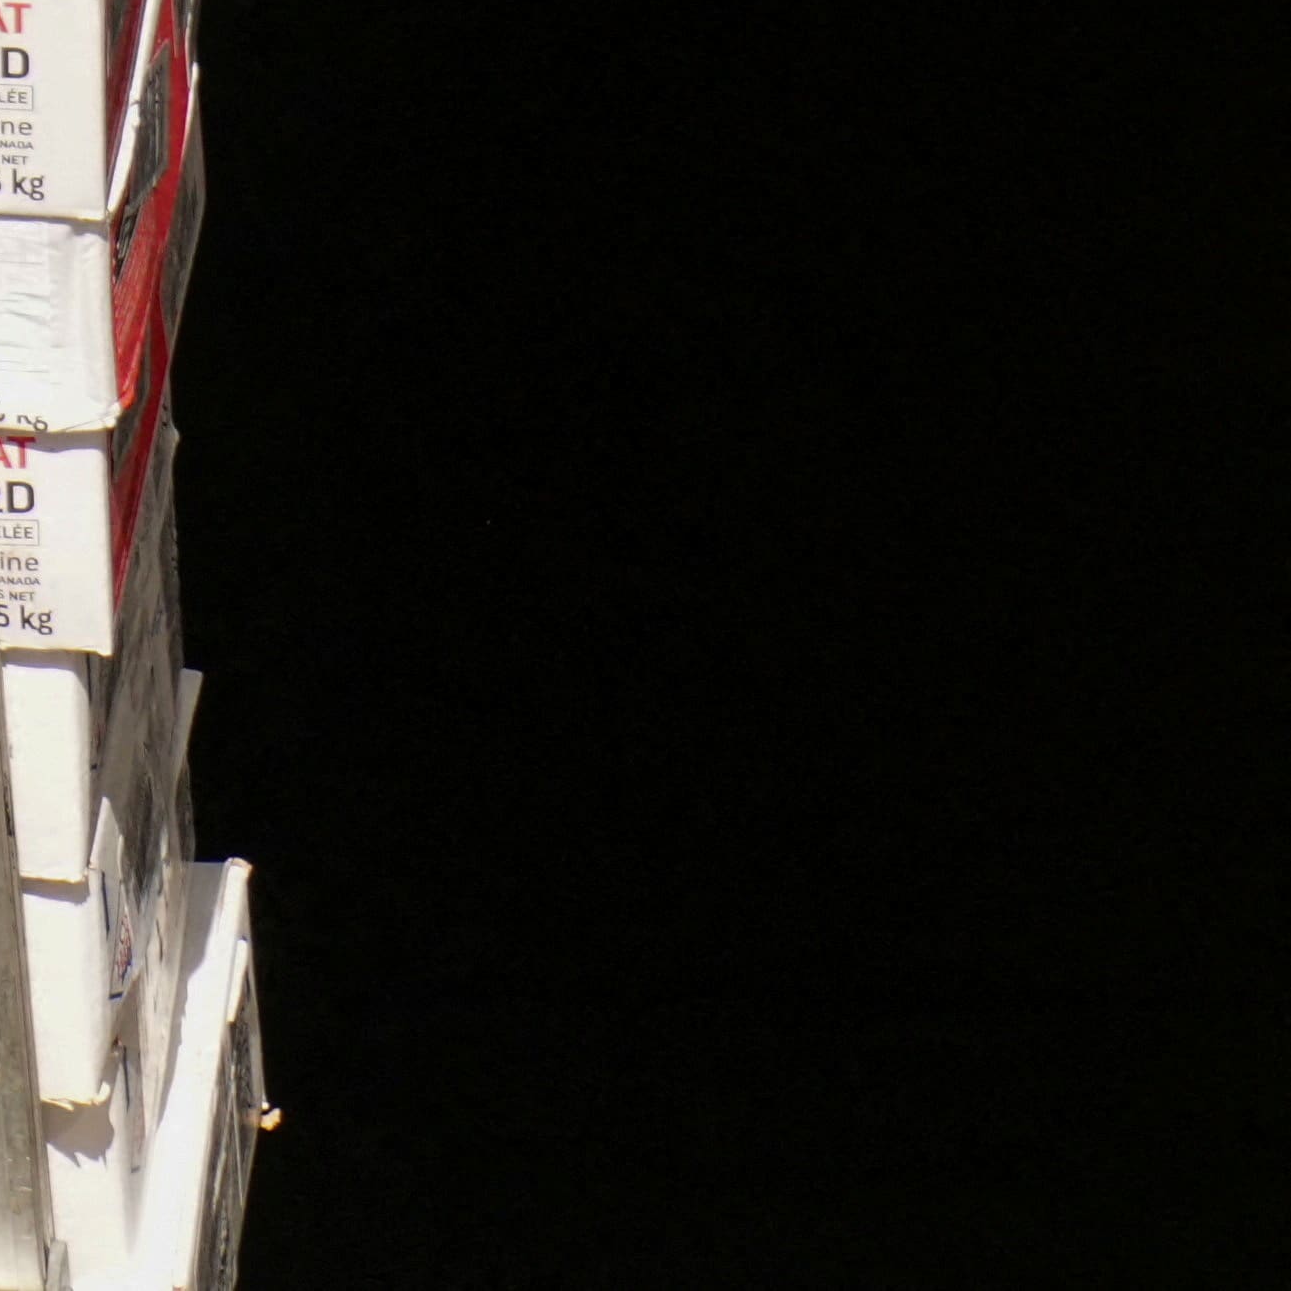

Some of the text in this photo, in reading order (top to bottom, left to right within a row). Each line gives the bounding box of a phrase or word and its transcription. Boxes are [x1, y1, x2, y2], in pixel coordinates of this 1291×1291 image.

[1, 155, 29, 166] NET
[12, 168, 45, 202] kg
[9, 591, 35, 602] NET
[20, 604, 54, 636] kg
